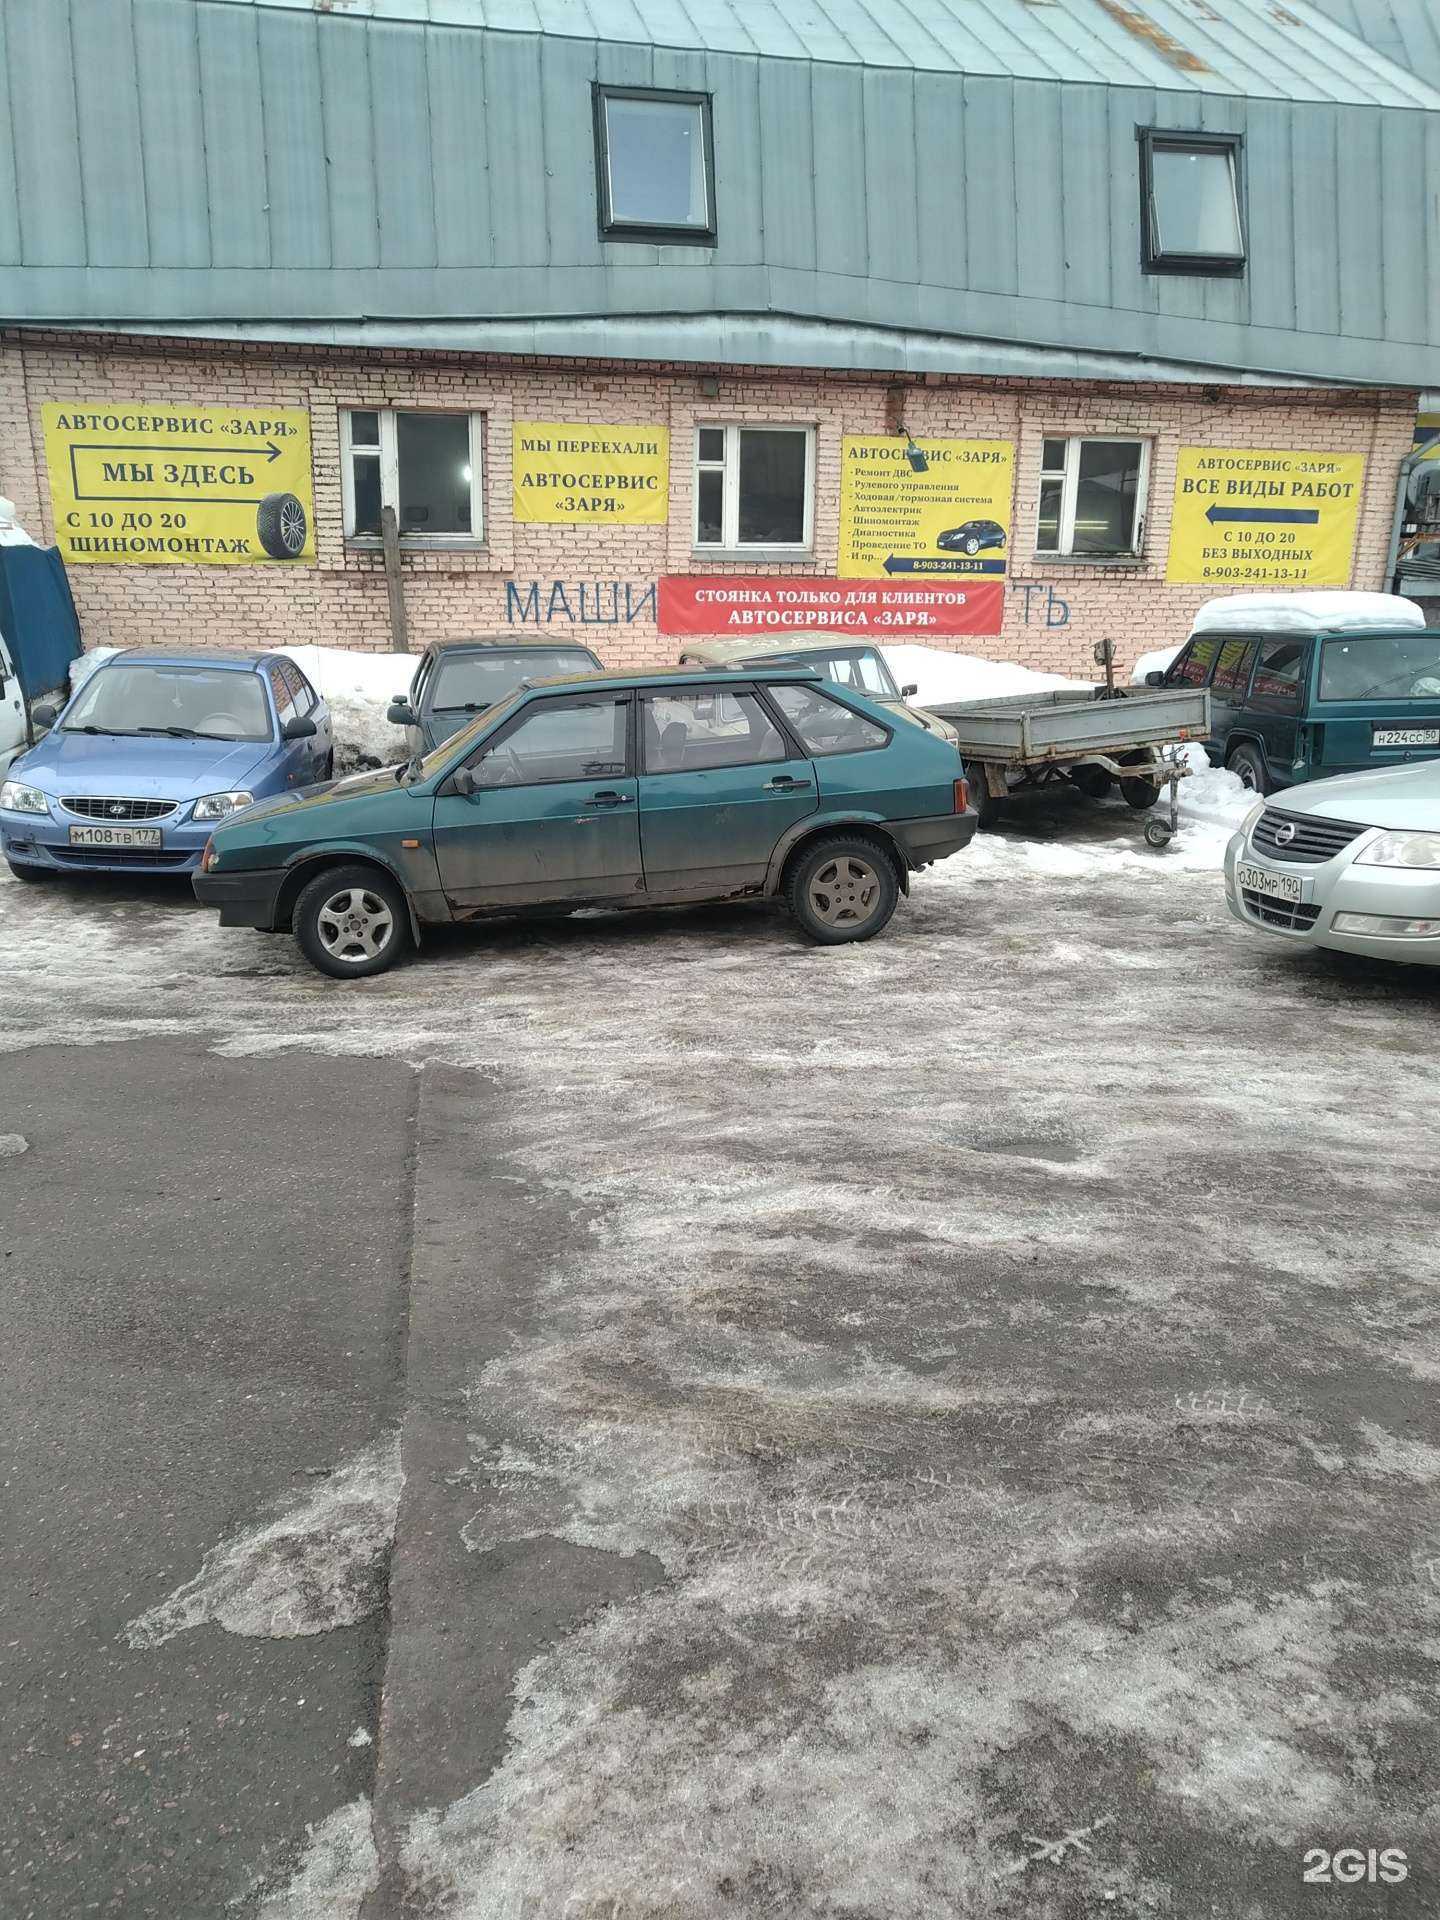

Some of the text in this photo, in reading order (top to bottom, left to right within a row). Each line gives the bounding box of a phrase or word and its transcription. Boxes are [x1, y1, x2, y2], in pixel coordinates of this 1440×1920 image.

[56, 413, 298, 437] АВТОСЕРВИС «ЗАРЯ»
[521, 439, 658, 456] МЫ ПЕРЕЕХАЛИ
[955, 451, 1007, 463] «ЗАРЯ»
[1197, 458, 1341, 473] АВТОСЕРВИС «ЗАРЯ»
[102, 462, 255, 488] МЫ ЗДЕСЬ
[855, 468, 913, 478] Ремонт ДВС
[521, 473, 658, 490] АВТОСЕРВИС
[855, 480, 960, 492] Рулевого управления
[1182, 478, 1354, 498] ВСЕ ВИДЫ РАБОТ
[555, 496, 625, 512] «ЗАРЯ»
[853, 505, 922, 515] Автоэлектрик
[66, 512, 187, 531] С 10 ДО 20
[853, 516, 920, 526] Шиномонтаж
[852, 528, 916, 538] Диагностика
[1224, 532, 1296, 544] С 10 ДО 20
[68, 536, 250, 554] ШИНОМОНТАЖ
[852, 541, 927, 550] Проведение ТО
[1202, 548, 1313, 561] БЕЗ ВЫХОДНЫХ
[913, 561, 983, 570] 8-903-241-13-11
[1203, 567, 1308, 579] 8-903-241-13-11
[695, 590, 966, 606] СТОЯНКА ТОЛЬКО ДЛЯ КЛИЕНТОВ
[728, 610, 937, 626] АВТОСЕРВИСА «ЗАРЯ»
